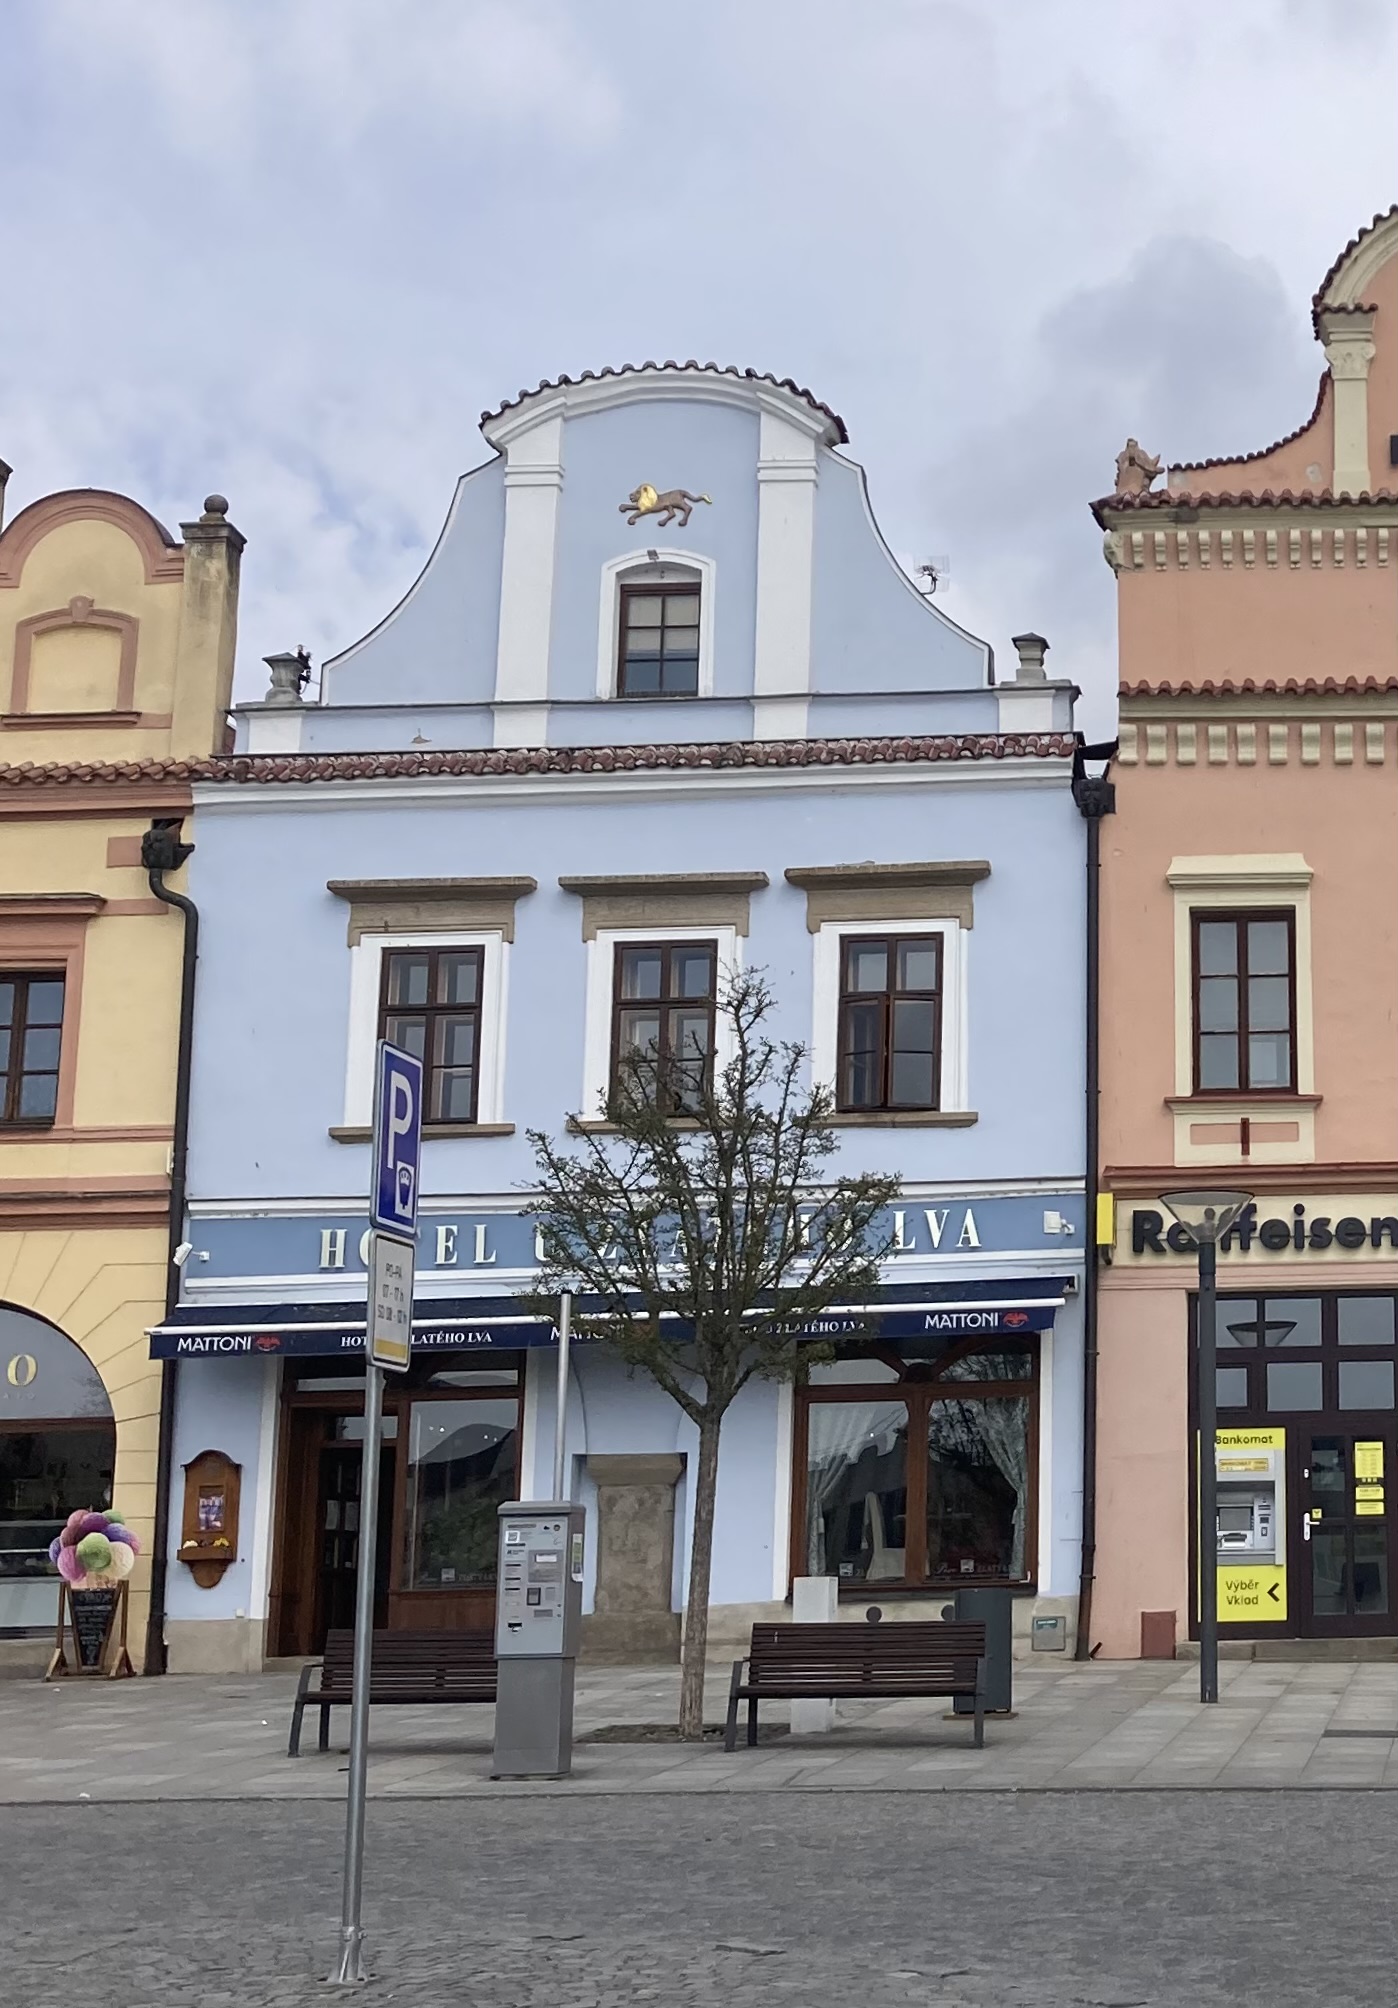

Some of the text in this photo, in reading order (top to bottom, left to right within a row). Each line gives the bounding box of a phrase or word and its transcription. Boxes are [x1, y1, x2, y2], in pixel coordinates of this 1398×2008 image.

[386, 1069, 413, 1169] P
[319, 1223, 497, 1269] HEL
[892, 1207, 982, 1250] LVA
[925, 1312, 999, 1329] MATTONI
[177, 1335, 252, 1352] MATTONI
[411, 1330, 465, 1346] LATÉHO
[468, 1330, 493, 1344] LVA
[1216, 1434, 1274, 1445] Bankomat
[1225, 1579, 1260, 1594] Výběr
[1226, 1594, 1259, 1606] Vklad
